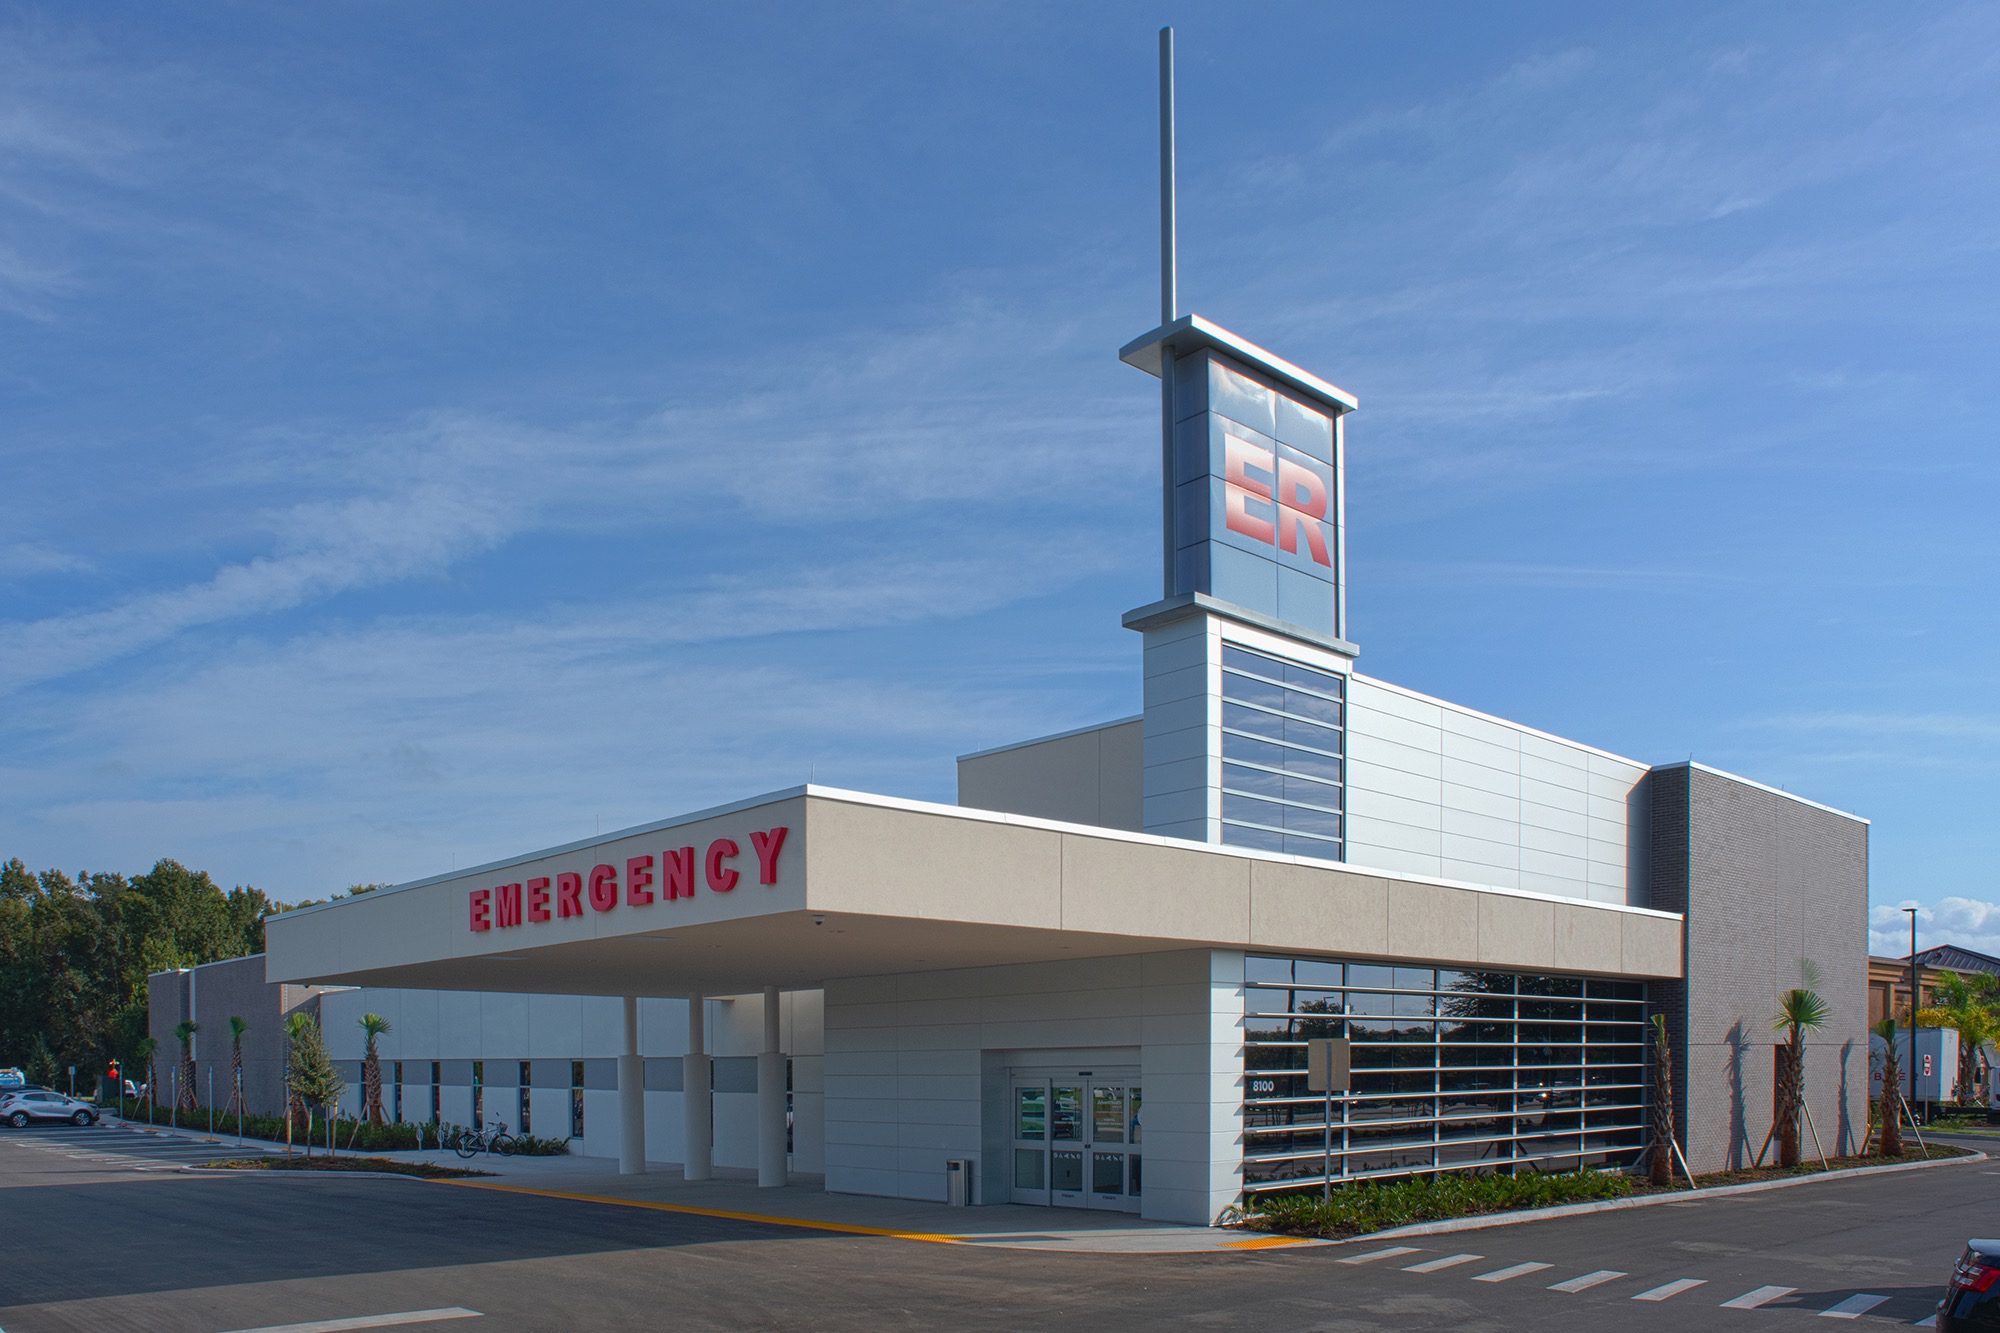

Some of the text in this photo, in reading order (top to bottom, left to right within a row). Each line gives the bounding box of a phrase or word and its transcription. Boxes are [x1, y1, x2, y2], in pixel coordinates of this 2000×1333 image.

[1224, 433, 1331, 568] ER
[469, 827, 788, 932] EMERGENCY
[1252, 1080, 1274, 1092] 8100
